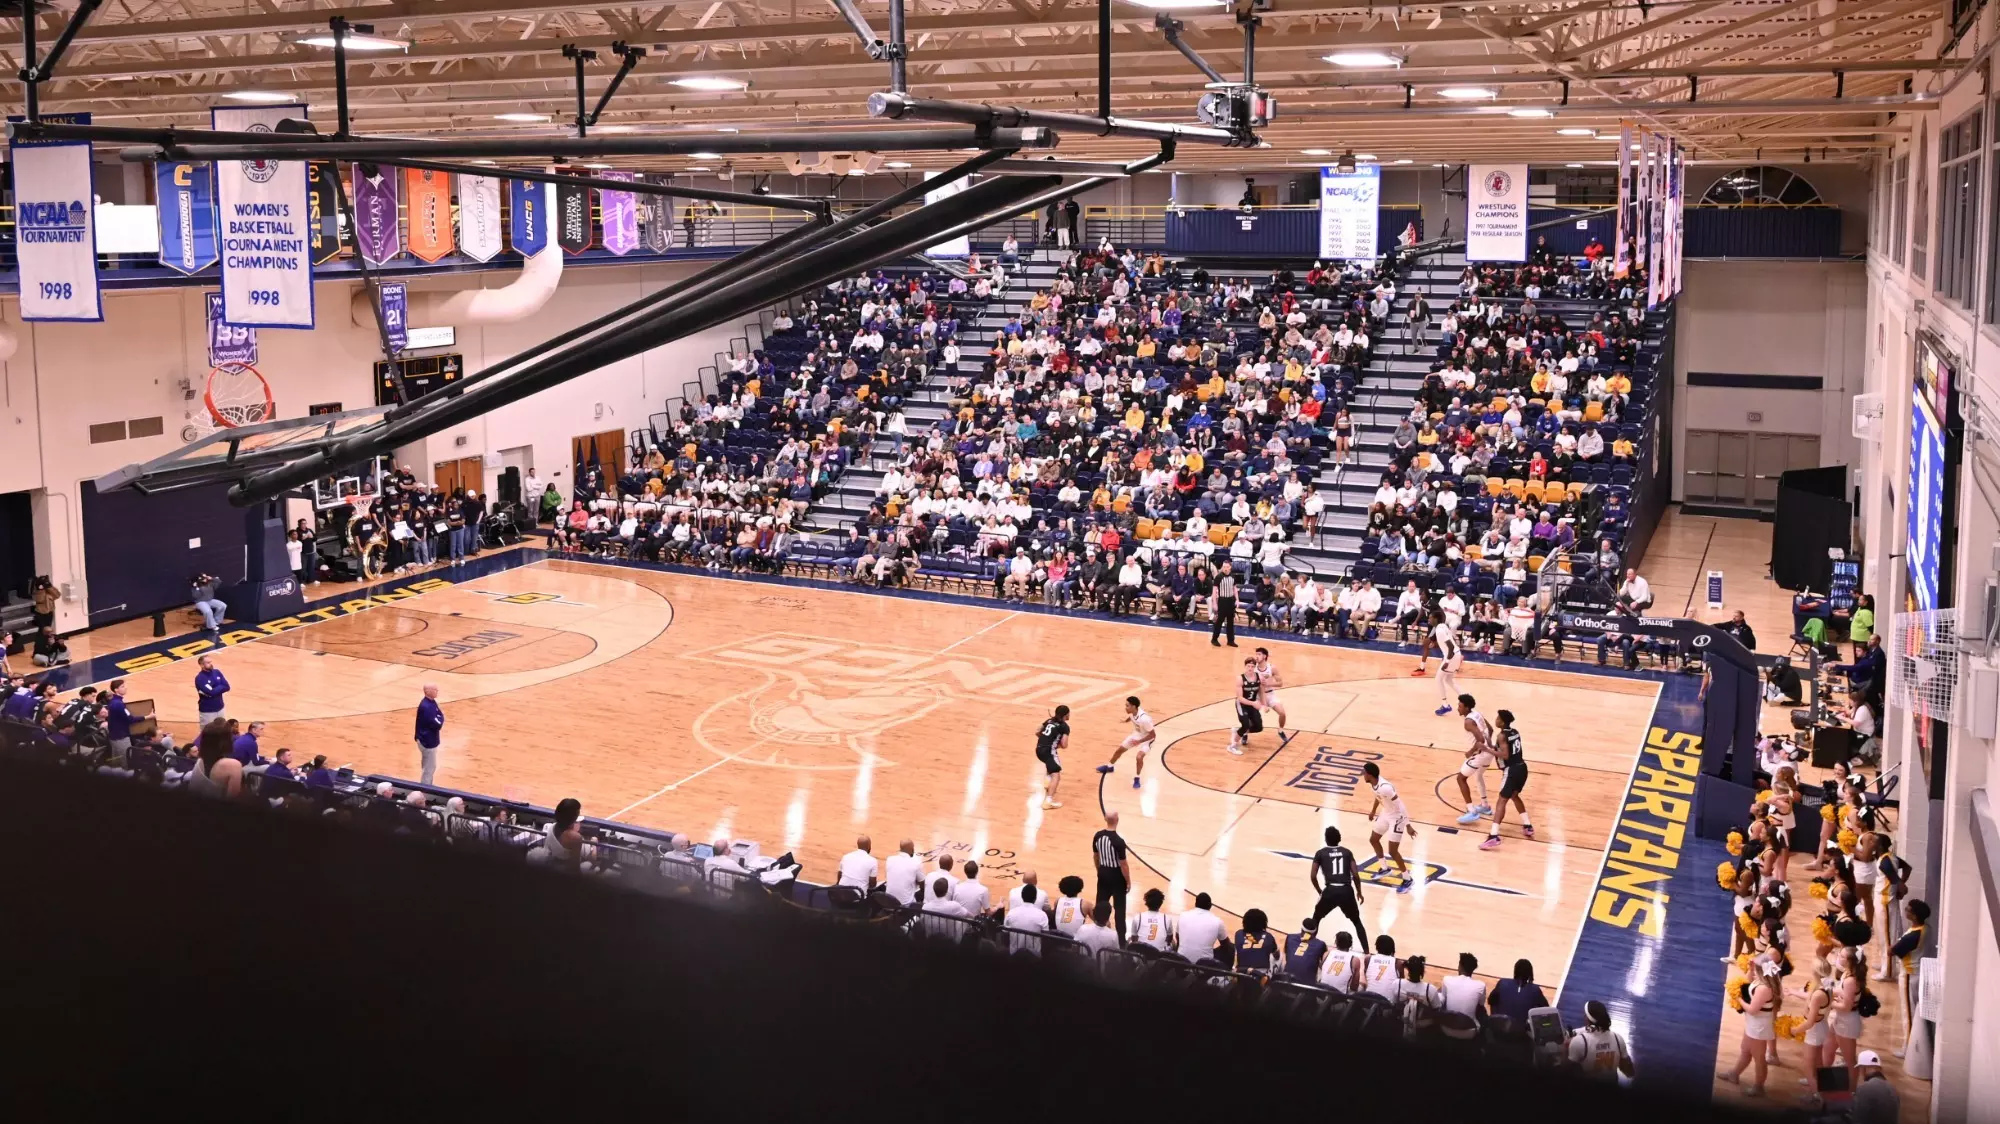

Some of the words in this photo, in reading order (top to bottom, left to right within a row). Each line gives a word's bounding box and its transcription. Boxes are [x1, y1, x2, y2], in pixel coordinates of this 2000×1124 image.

[1326, 187, 1353, 196] NCAA
[19, 201, 70, 227] NCAA
[234, 203, 289, 217] WOMEN'S
[229, 221, 294, 235] BASKETBALL
[371, 195, 381, 257] FURMAN
[525, 199, 534, 241] UNCG
[19, 227, 85, 243] TOURNAMENT
[223, 238, 304, 252] TOURNAMENT
[227, 256, 298, 270] CHAMPIONS
[39, 282, 72, 300] 1998
[248, 290, 280, 306] 1998
[382, 286, 402, 295] BOONE
[387, 309, 401, 326] 21
[115, 577, 453, 674] SPARTANS
[1574, 616, 1620, 632] OrthoCare
[1638, 618, 1674, 628] SPALDING
[1512, 739, 1521, 755] 19
[1284, 746, 1384, 797] SOCON
[1589, 726, 1703, 938] SPARTANS
[936, 840, 1016, 859] CORT
[1331, 857, 1344, 875] 11
[1061, 907, 1075, 924] 13
[1147, 923, 1158, 941] 3
[1294, 941, 1309, 957] 2
[1327, 960, 1345, 977] 14
[1375, 965, 1388, 981] 7
